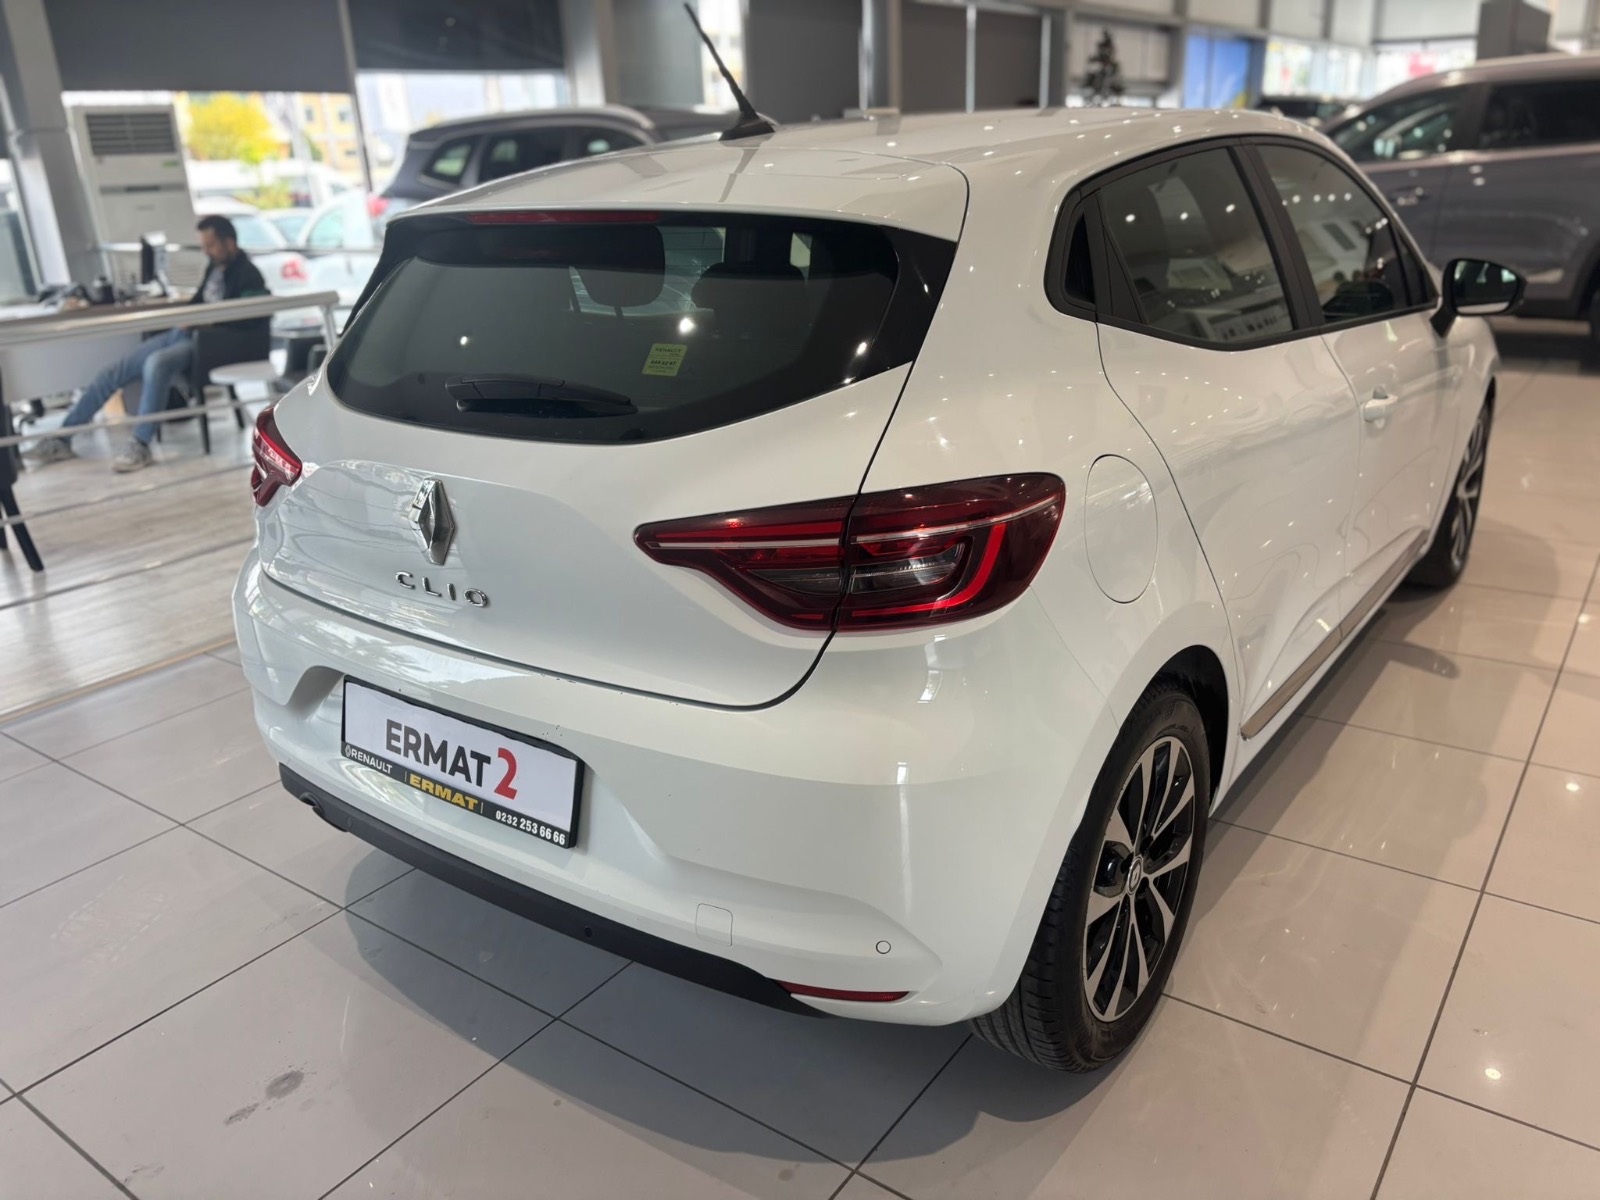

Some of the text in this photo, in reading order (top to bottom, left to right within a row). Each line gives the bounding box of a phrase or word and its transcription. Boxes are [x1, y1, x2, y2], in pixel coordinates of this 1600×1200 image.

[395, 571, 489, 608] CLIO
[351, 748, 566, 846] RENAULT ERMAT 0232 253 66 66
[386, 718, 518, 800] ERMAT 2
